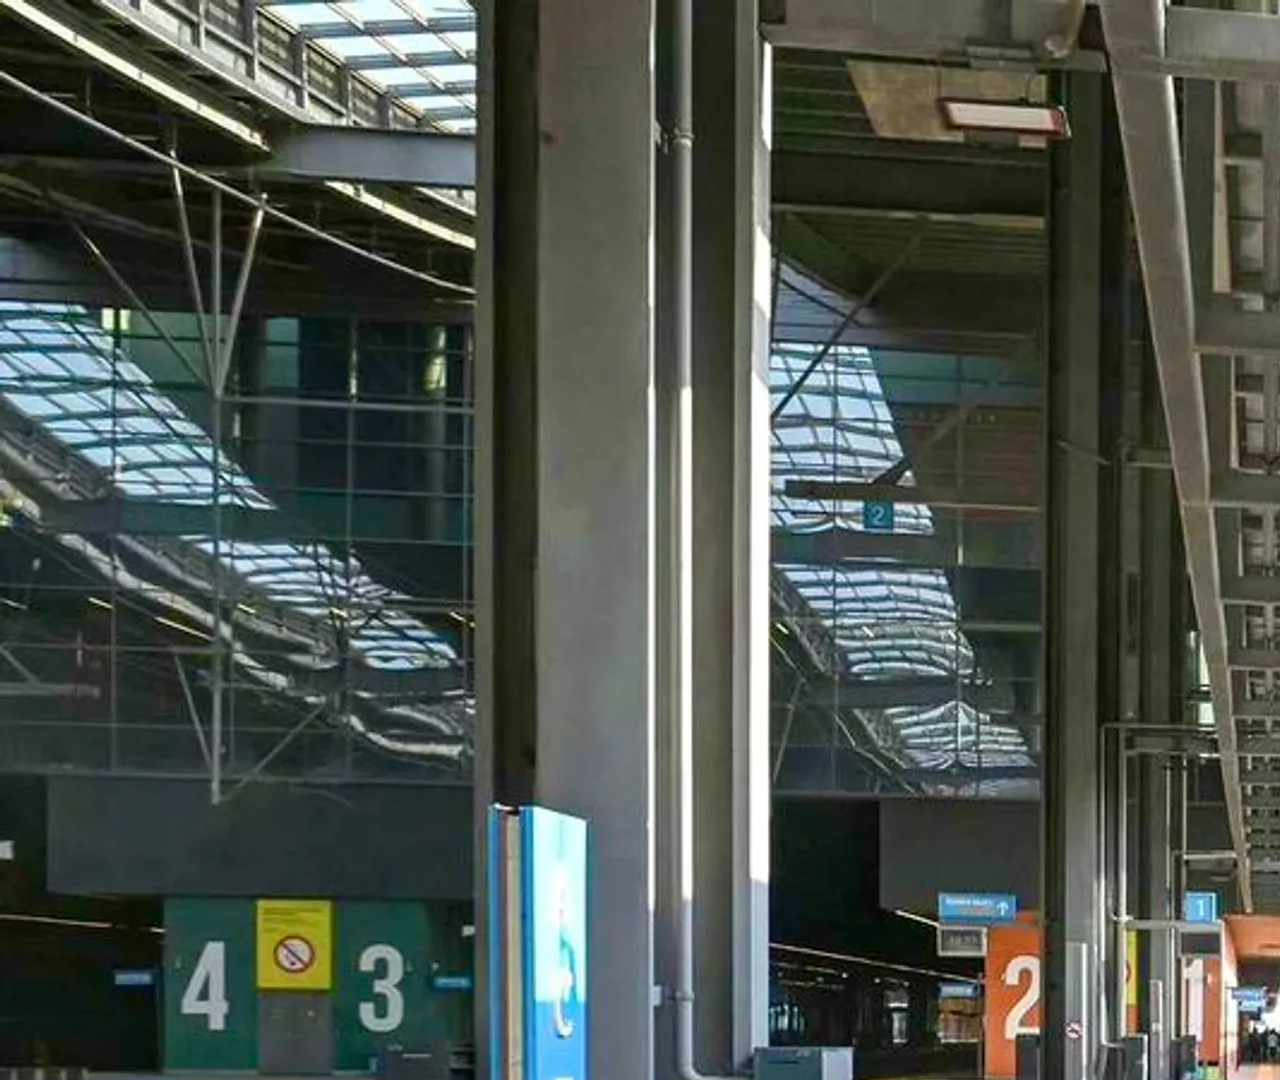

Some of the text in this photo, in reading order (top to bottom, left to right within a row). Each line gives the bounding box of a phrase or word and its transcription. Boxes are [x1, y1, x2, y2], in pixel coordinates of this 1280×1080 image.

[181, 941, 229, 1030] 4
[358, 943, 405, 1033] 3
[1004, 955, 1041, 1041] 2
